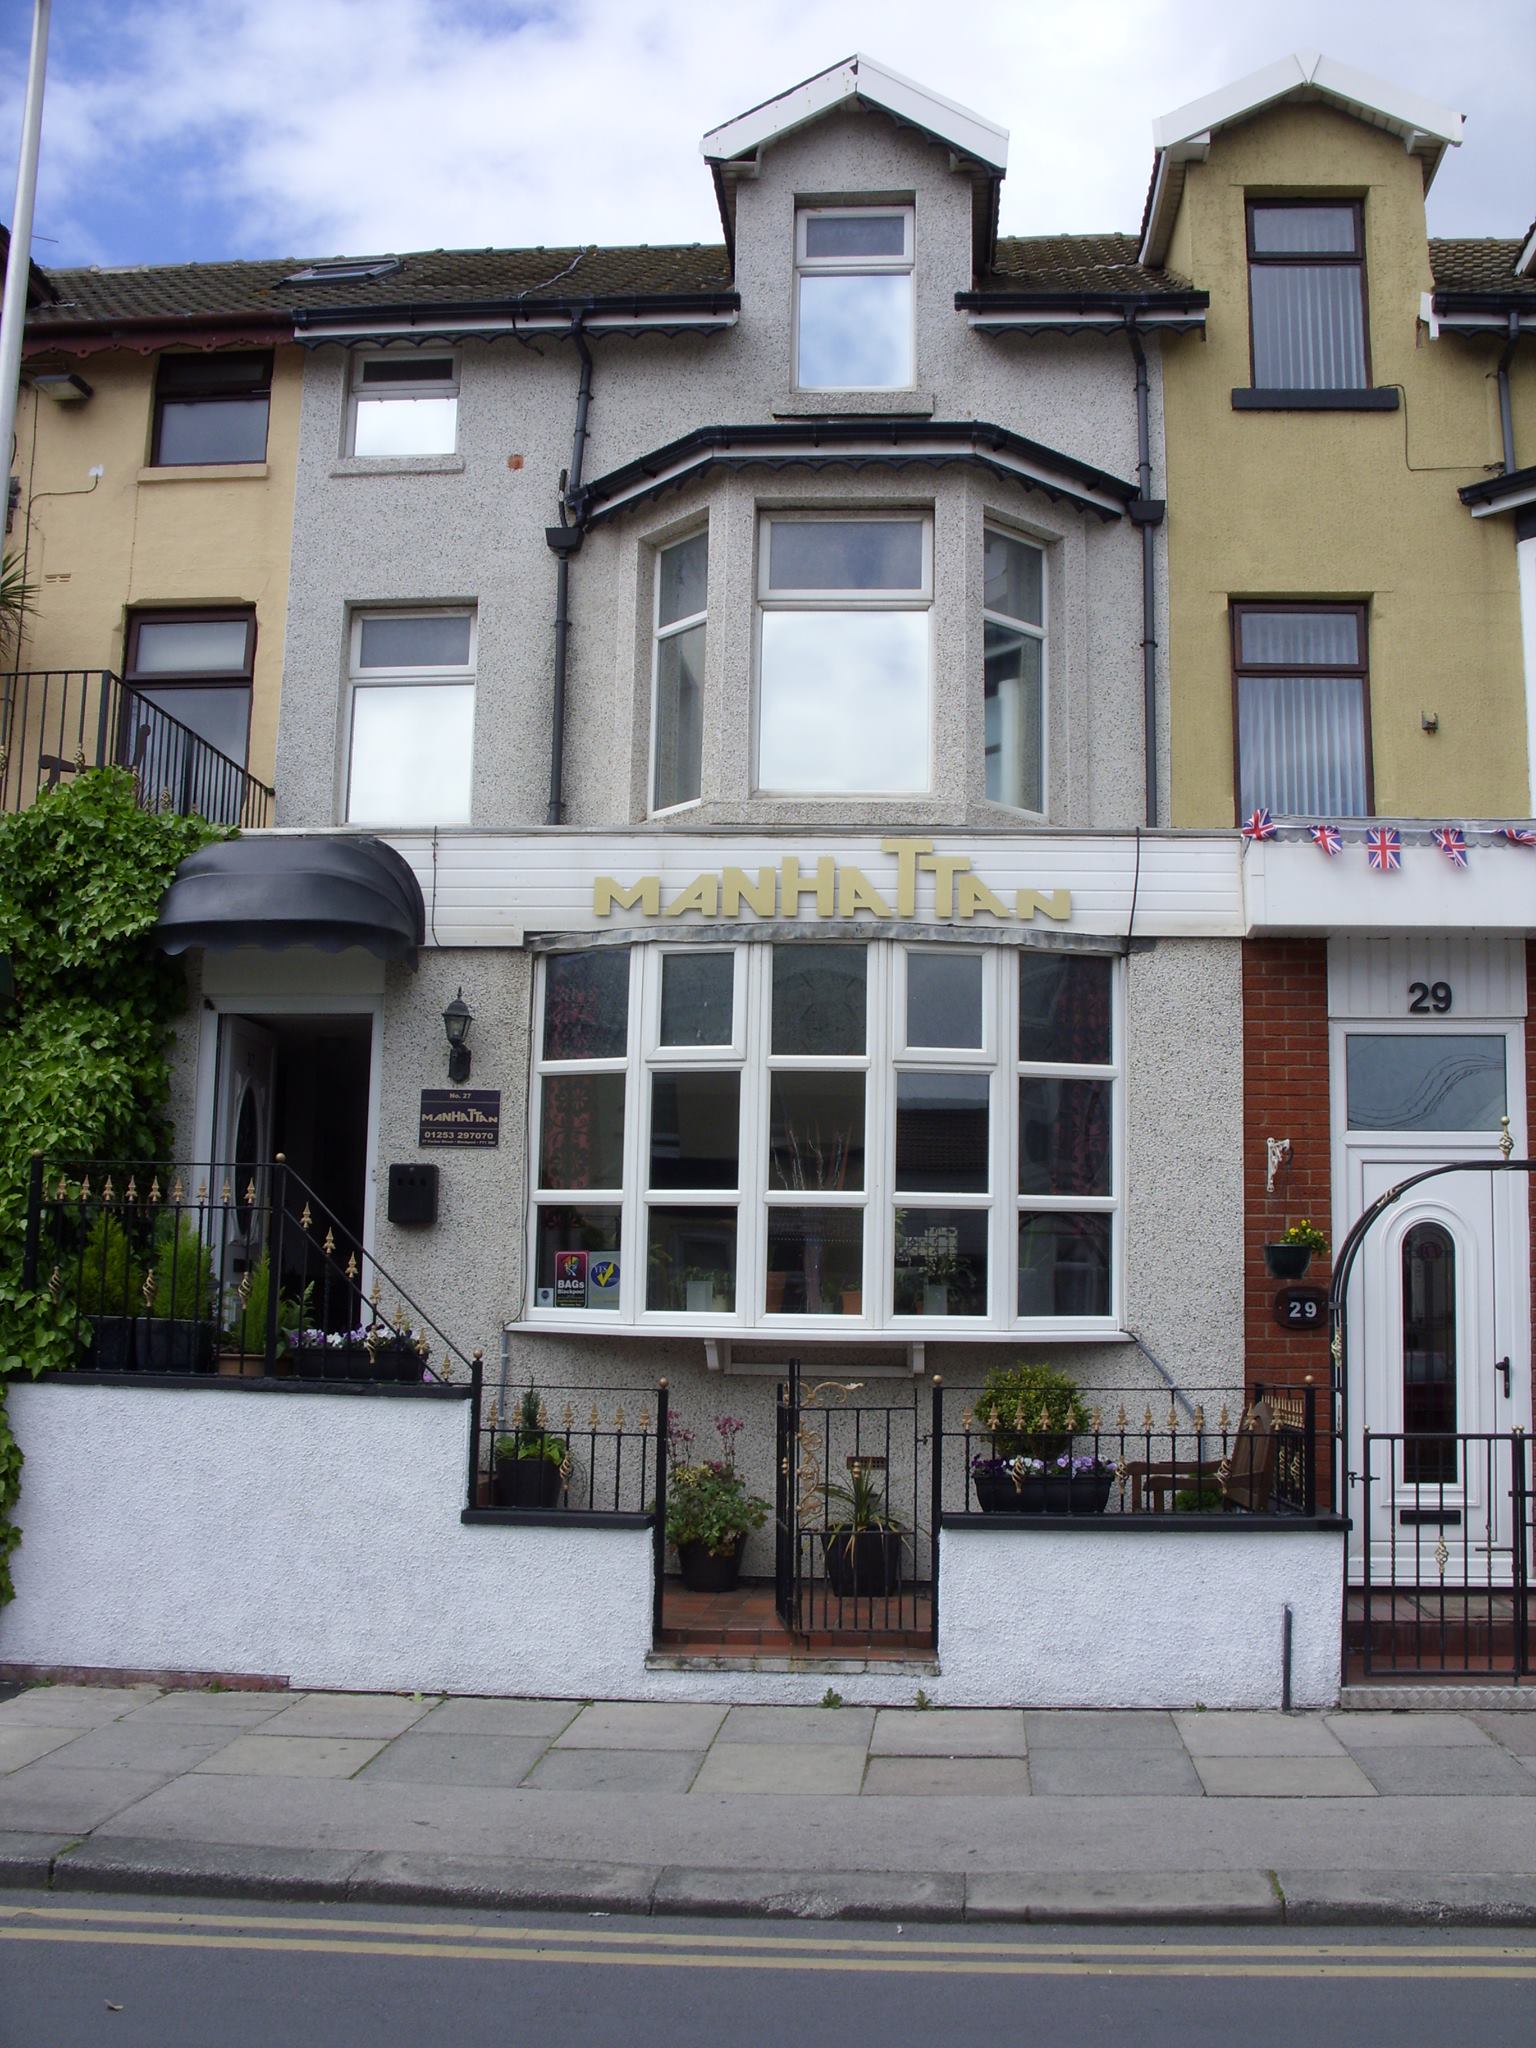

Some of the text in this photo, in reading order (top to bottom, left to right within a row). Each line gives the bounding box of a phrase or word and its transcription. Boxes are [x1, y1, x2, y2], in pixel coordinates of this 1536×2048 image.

[593, 838, 1072, 921] MANHATTAN
[1408, 981, 1452, 1014] 29
[422, 1108, 498, 1123] MANHATTAN
[424, 1131, 494, 1140] 01253 297070
[557, 1280, 585, 1289] BAGs
[1289, 1301, 1317, 1318] 29
